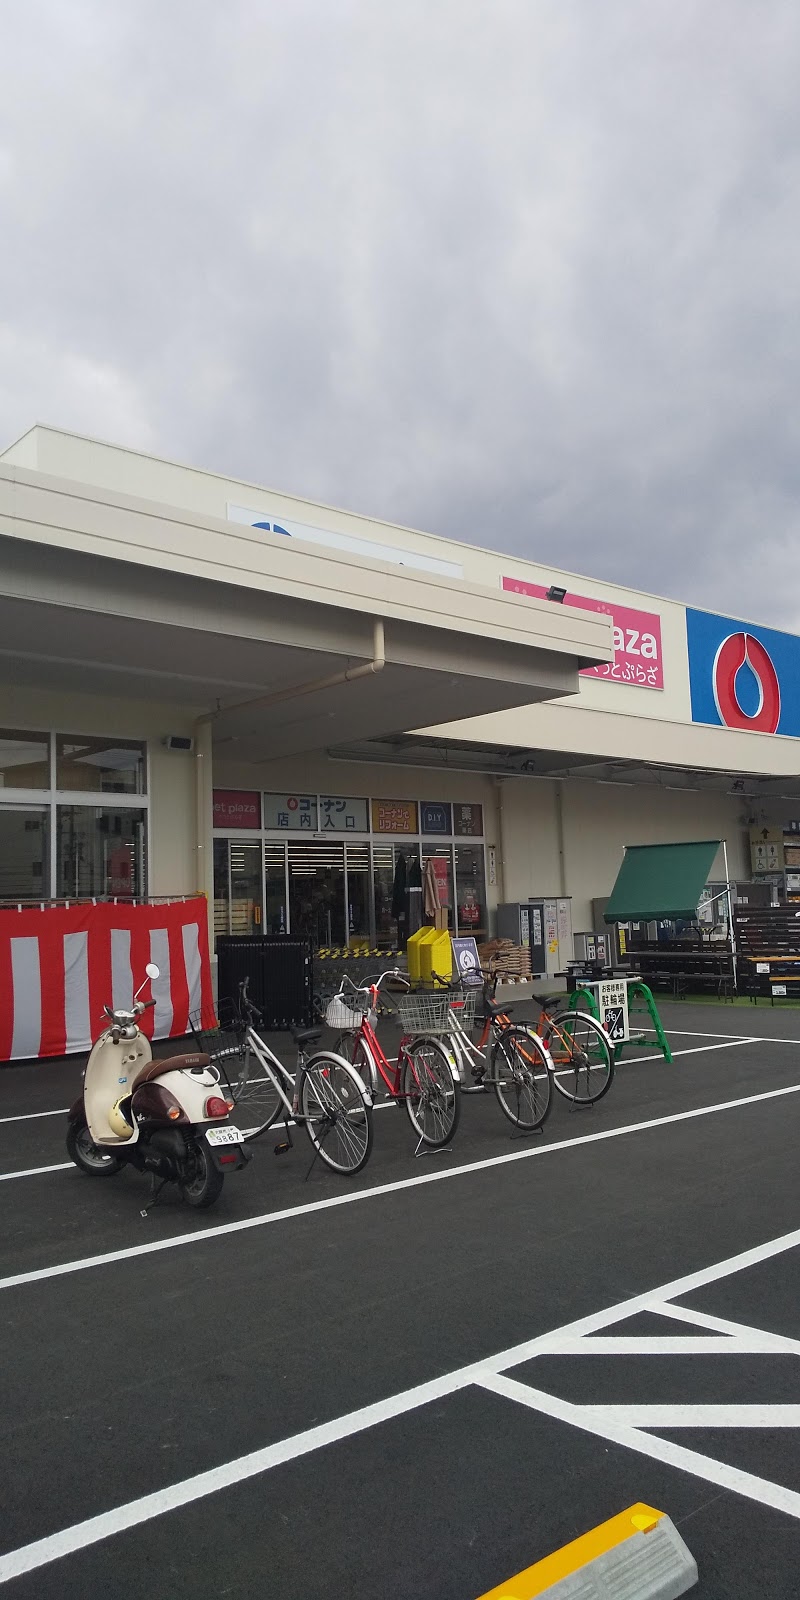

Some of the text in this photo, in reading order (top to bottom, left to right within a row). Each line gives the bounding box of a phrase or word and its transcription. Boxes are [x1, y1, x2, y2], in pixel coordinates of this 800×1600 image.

[594, 662, 658, 684] っとぷらざ
[229, 804, 256, 815] plaza
[300, 798, 347, 813] コーナン
[378, 808, 410, 819] コーナンで
[461, 806, 472, 820] 薬
[277, 812, 356, 829] 店内入口
[378, 819, 410, 830] リフォーム
[602, 993, 625, 1006] 駐輪場
[216, 1132, 240, 1143] 9887
